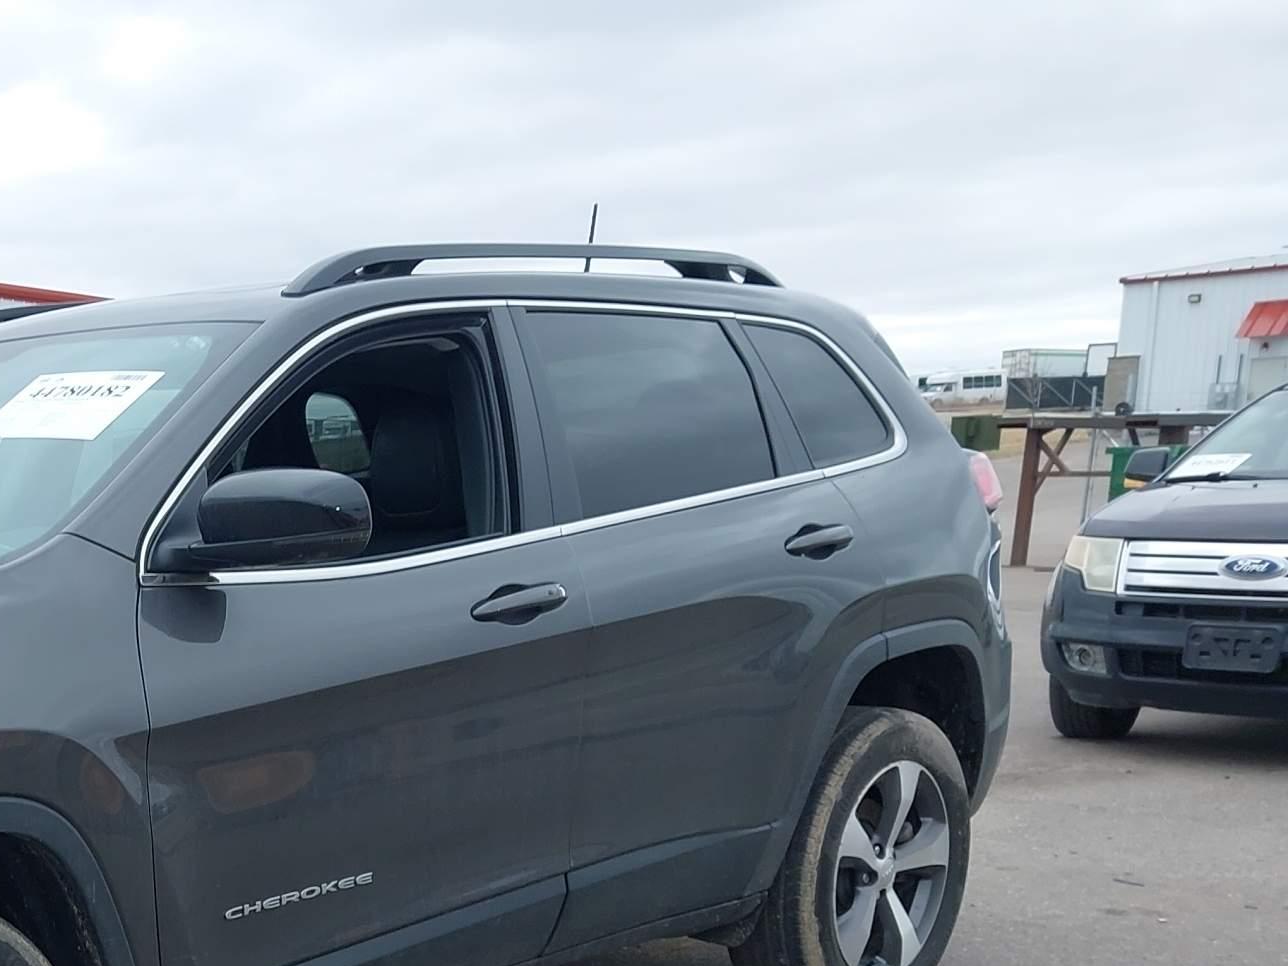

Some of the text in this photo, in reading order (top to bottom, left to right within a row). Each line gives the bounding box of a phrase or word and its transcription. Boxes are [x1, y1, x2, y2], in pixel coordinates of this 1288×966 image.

[29, 384, 131, 398] 44780182
[1233, 559, 1270, 573] Ford
[224, 871, 374, 920] CHEROKEE
